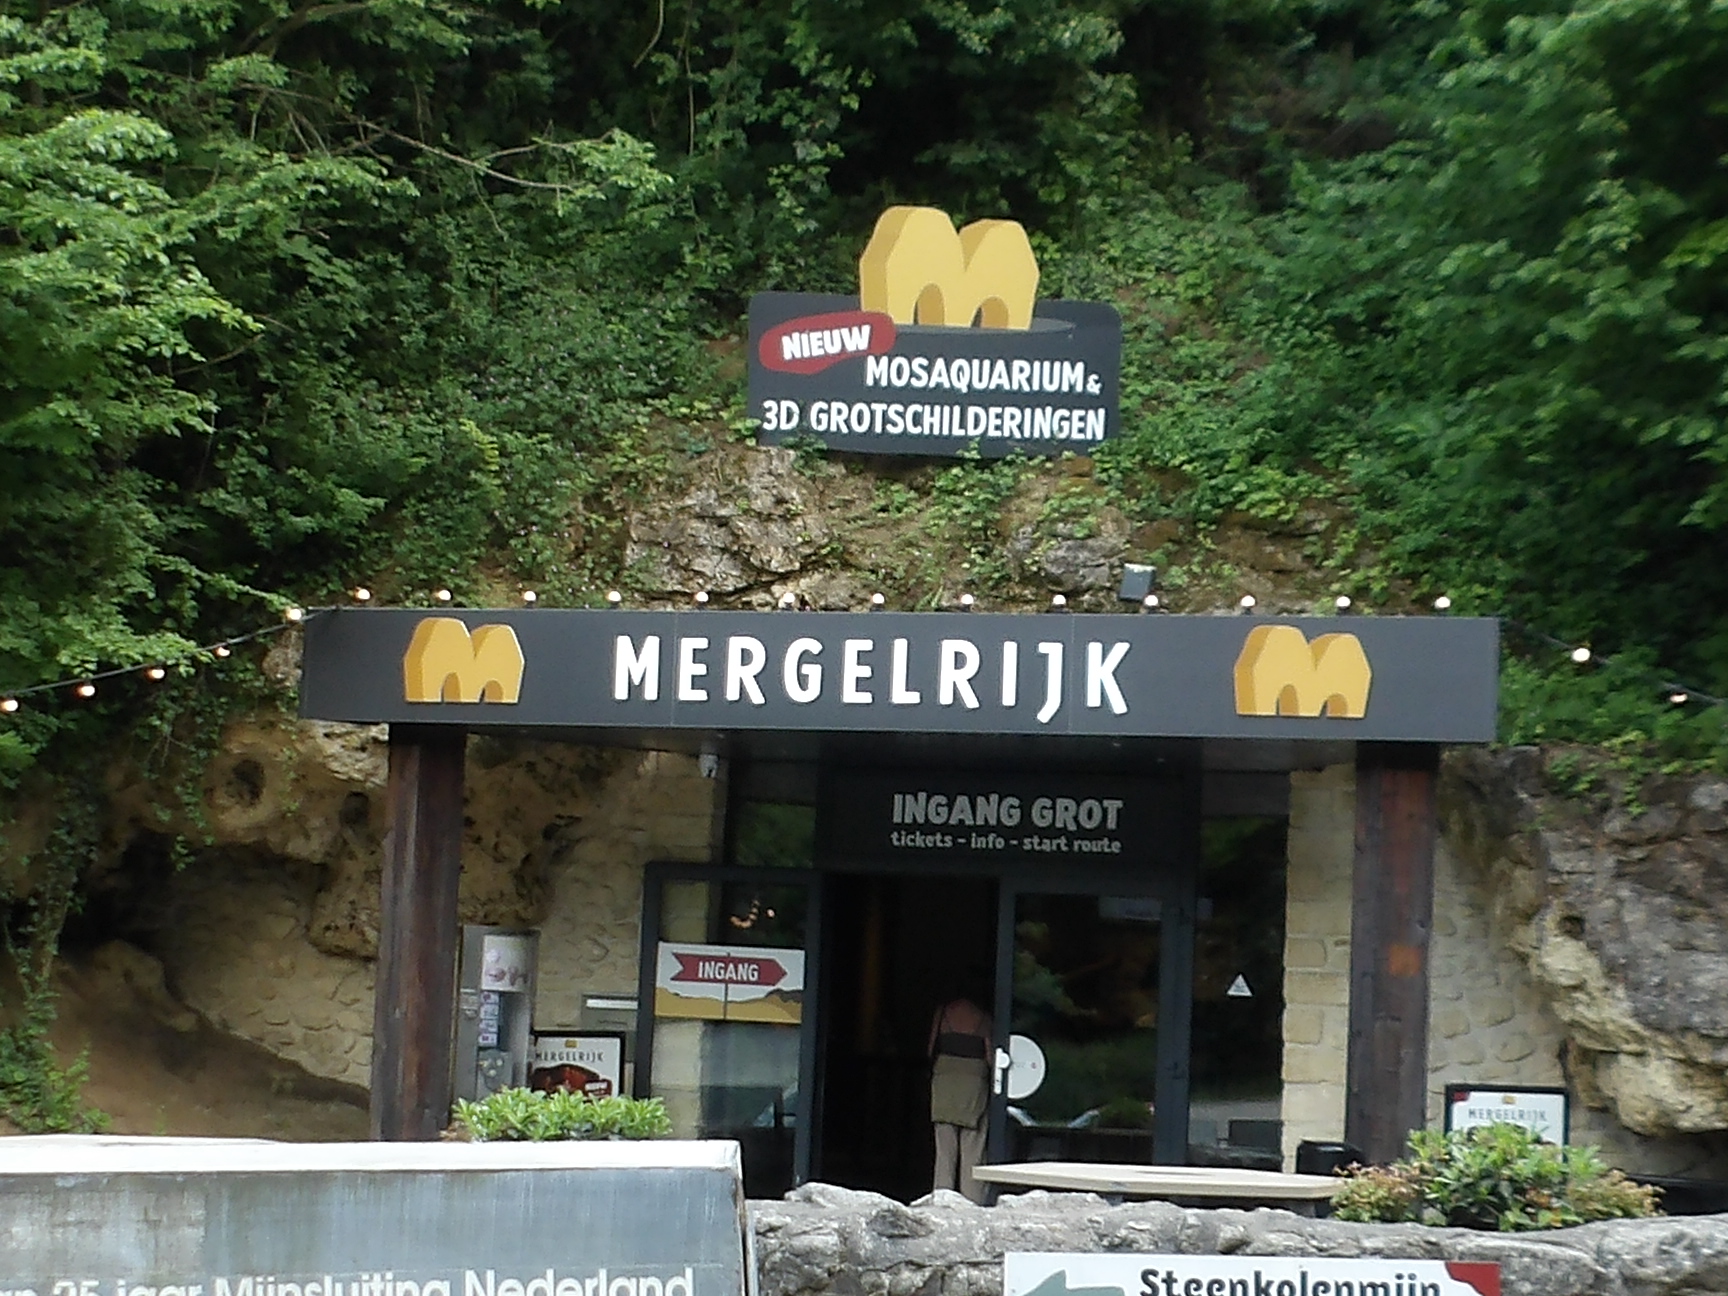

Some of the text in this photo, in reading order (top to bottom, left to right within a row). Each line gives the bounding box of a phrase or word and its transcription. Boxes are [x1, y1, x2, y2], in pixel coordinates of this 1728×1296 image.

[781, 324, 871, 361] NIEUW
[762, 400, 1106, 441] 3D GROTSCHILDERINGEN
[613, 635, 1131, 724] MERGELRIJK
[892, 792, 1124, 831] INGANG GROT
[890, 830, 954, 848] tickets
[971, 832, 1006, 850] info
[1022, 835, 1069, 853] start
[1072, 837, 1122, 853] route
[697, 961, 760, 982] INGANG
[535, 1050, 605, 1063] MERGELRIJK
[1468, 1108, 1548, 1122] MERGELRIJK
